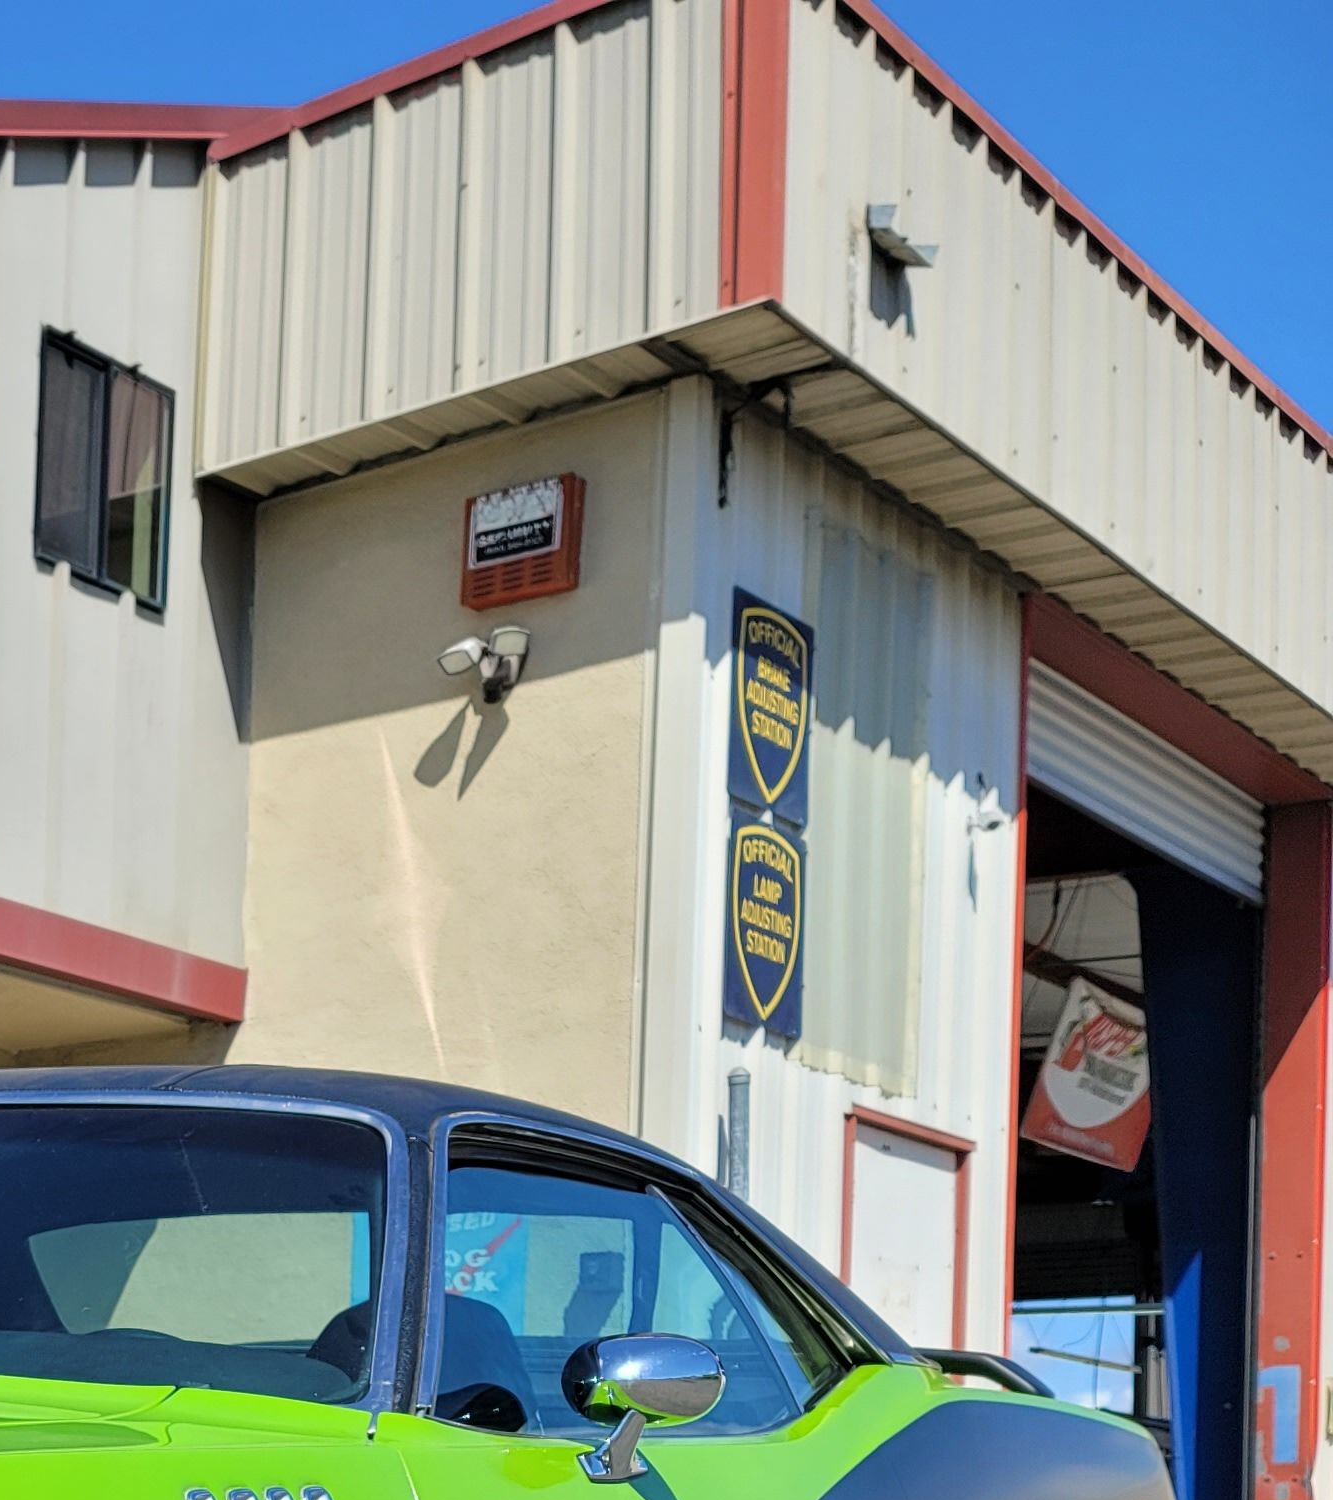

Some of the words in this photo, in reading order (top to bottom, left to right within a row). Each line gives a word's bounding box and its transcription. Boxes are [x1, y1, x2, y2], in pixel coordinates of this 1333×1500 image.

[748, 620, 800, 669] OFFICIAL
[757, 655, 791, 692] BRAKE
[746, 677, 800, 726] ADJUSTING
[751, 709, 792, 751] STATION
[743, 838, 793, 883] OFFICIAL
[754, 871, 782, 905] LAMP
[740, 896, 793, 940] ADJUSTING
[746, 928, 786, 965] STATION
[1256, 1364, 1301, 1464] 1
